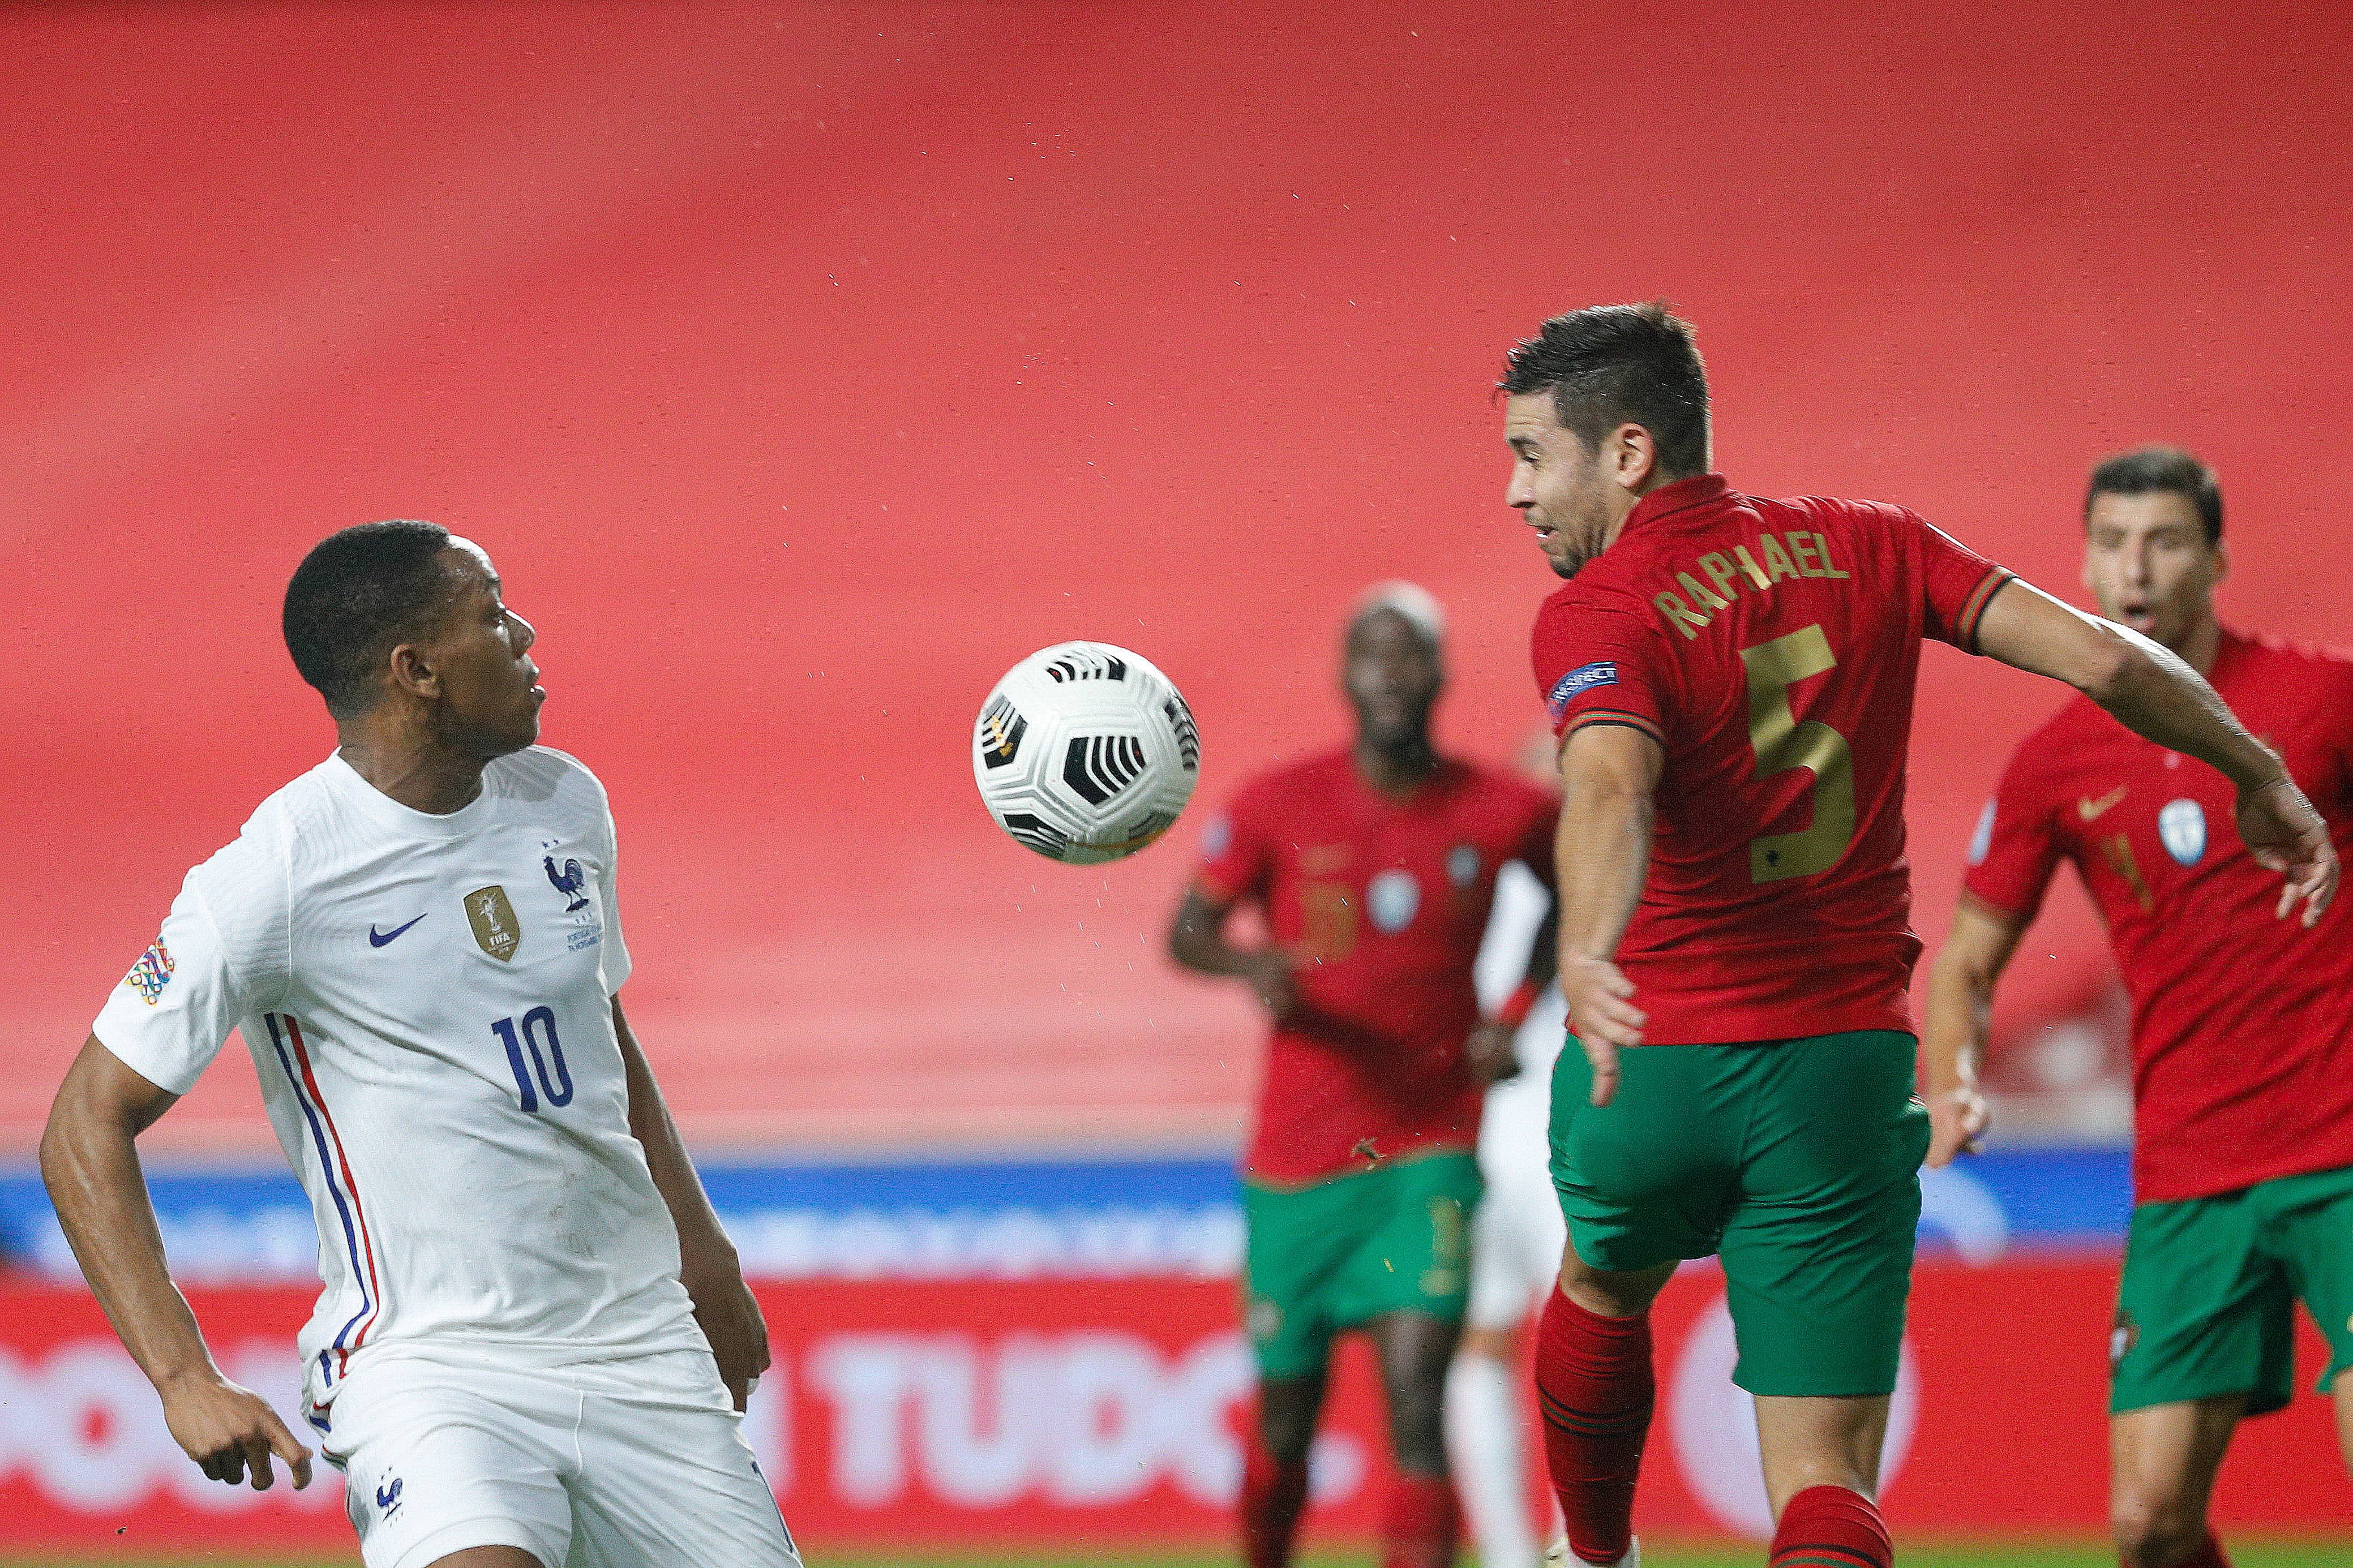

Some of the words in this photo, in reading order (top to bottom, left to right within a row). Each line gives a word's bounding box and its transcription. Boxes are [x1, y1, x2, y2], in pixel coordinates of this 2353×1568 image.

[1653, 530, 1850, 641] RAPHAEL
[1739, 623, 1855, 884] 5
[488, 932, 511, 947] FIFA
[491, 1006, 574, 1113] 10
